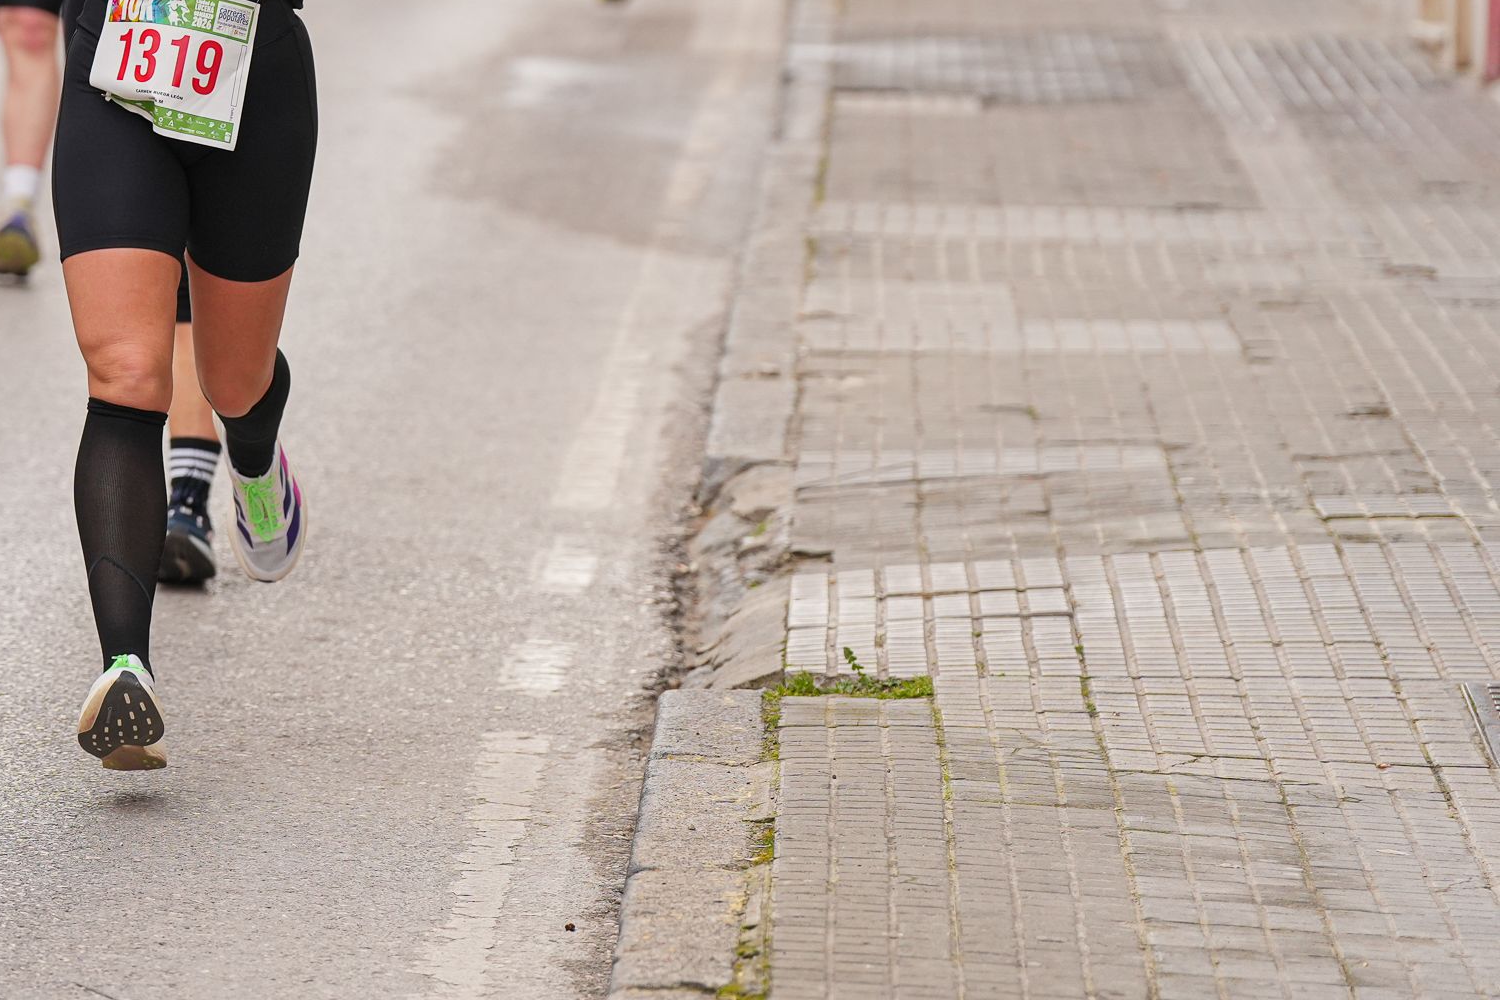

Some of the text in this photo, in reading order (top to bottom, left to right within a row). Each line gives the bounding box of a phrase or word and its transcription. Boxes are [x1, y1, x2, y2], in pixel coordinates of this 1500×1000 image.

[218, 13, 249, 25] populares
[220, 8, 246, 19] carreras
[192, 16, 212, 30] 2026
[116, 28, 224, 96] 1319
